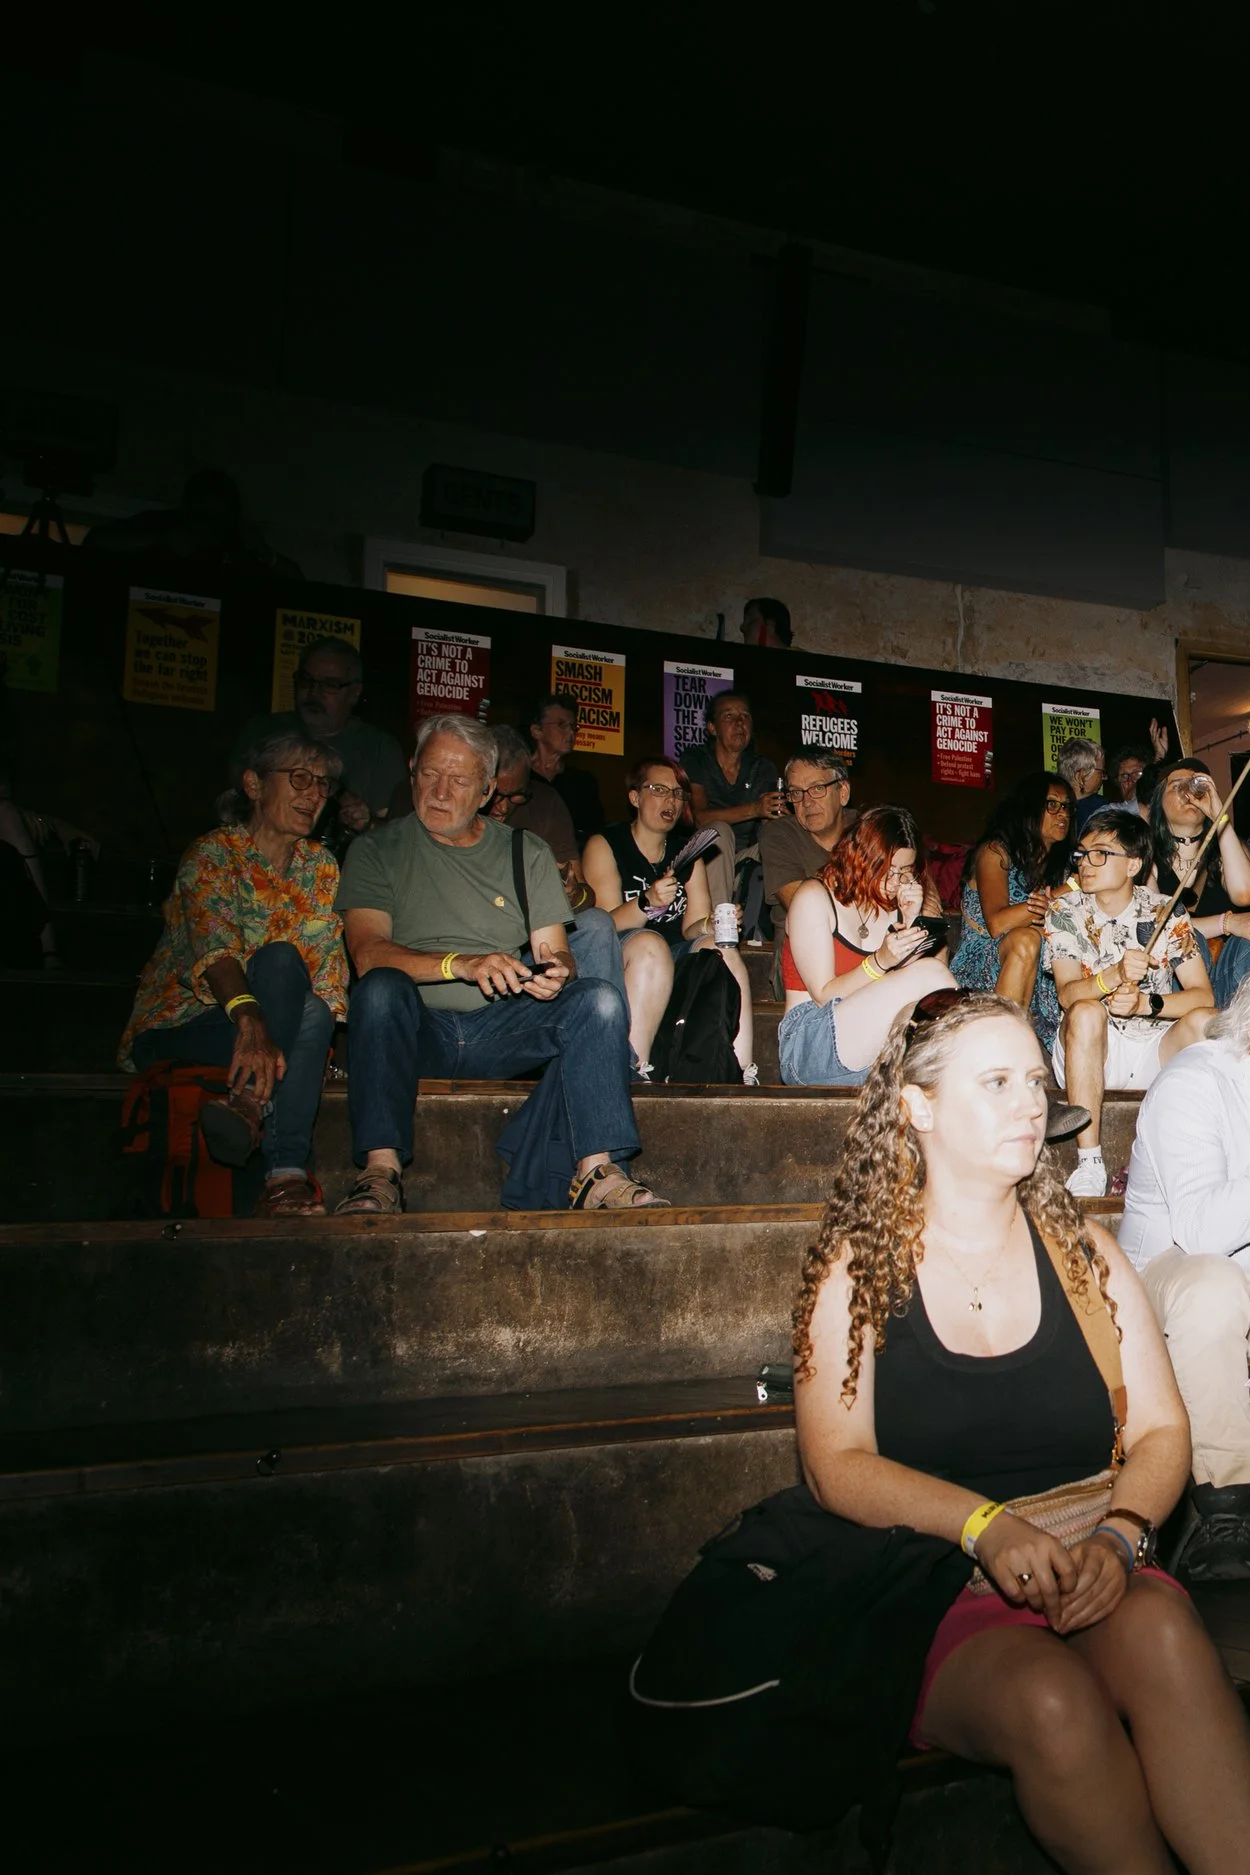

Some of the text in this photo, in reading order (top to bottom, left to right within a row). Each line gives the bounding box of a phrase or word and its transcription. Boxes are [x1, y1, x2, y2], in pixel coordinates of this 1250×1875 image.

[282, 613, 354, 636] MARXISM
[135, 629, 189, 649] Together
[424, 632, 480, 645] Socialist Worker
[155, 650, 176, 662] can
[180, 652, 208, 668] stop
[417, 640, 473, 661] IT'S NOT A
[564, 650, 614, 664] Socialist Worker
[133, 660, 209, 683] the far right
[417, 654, 469, 673] CRIME TO
[555, 660, 603, 682] SMASH
[676, 666, 722, 678] Socialist Worker
[416, 668, 485, 689] ACT AGAINST
[673, 675, 706, 694] TEAR
[804, 678, 854, 691] Socialist Worker
[416, 682, 470, 701] GENOCIDE
[555, 682, 613, 705] FASCISM
[940, 694, 984, 706] Socialist Worker
[576, 707, 621, 728] ACISM
[673, 708, 698, 726] THE
[936, 702, 979, 719] IT'S NOT A
[1052, 707, 1072, 715] Socialist
[801, 713, 858, 735] REFUGEES
[936, 714, 976, 730] CRIME TO
[1049, 715, 1093, 728] WE WON'T
[674, 725, 711, 743] SEXIS
[801, 729, 858, 750] WELCOME
[936, 726, 989, 743] ACT AGAINST
[1050, 725, 1087, 737] PAY FOR
[1050, 734, 1067, 744] THE
[936, 737, 978, 753] GENOCIDE
